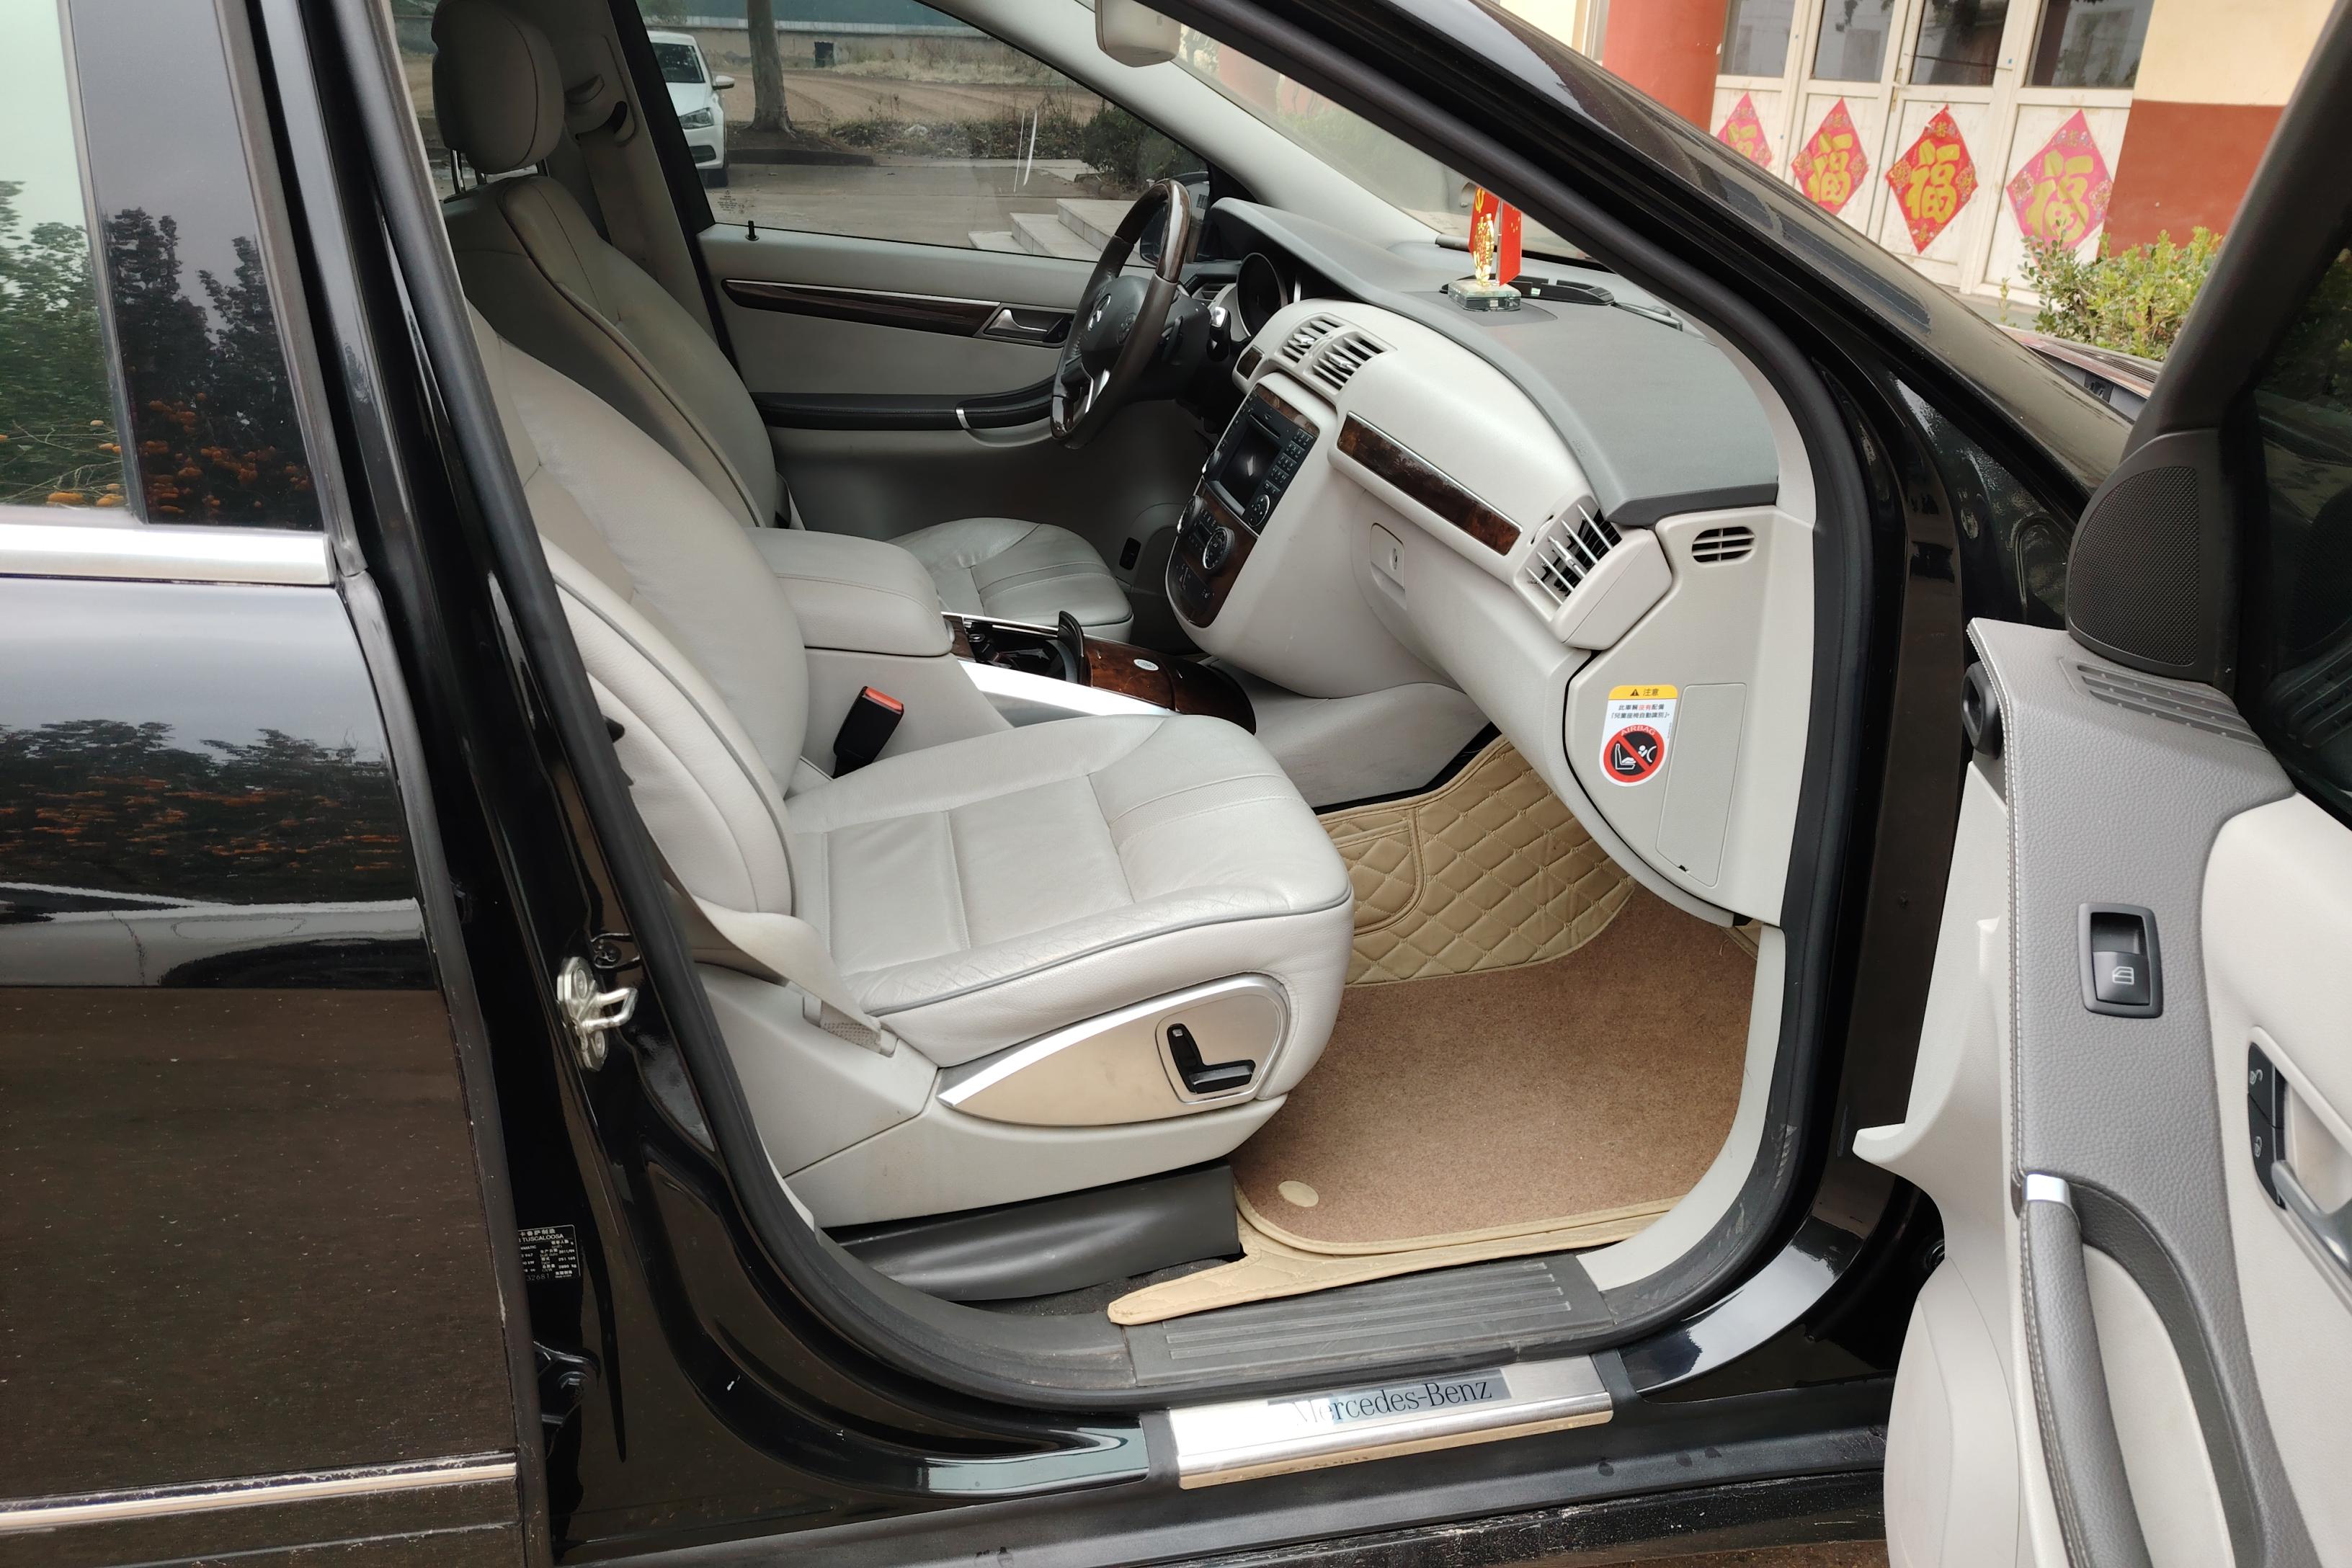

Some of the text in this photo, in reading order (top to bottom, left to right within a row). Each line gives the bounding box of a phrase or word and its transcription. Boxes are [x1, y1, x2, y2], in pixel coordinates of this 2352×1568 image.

[1807, 133, 1853, 205] 福
[1905, 139, 1960, 224] 福
[2026, 150, 2093, 242] 福
[1643, 688, 1660, 697] 注意
[1621, 725, 1656, 736] AIRBAG
[522, 1233, 564, 1243] TUSCALOOSA
[1292, 1381, 1493, 1426] Mercedes-Benz
